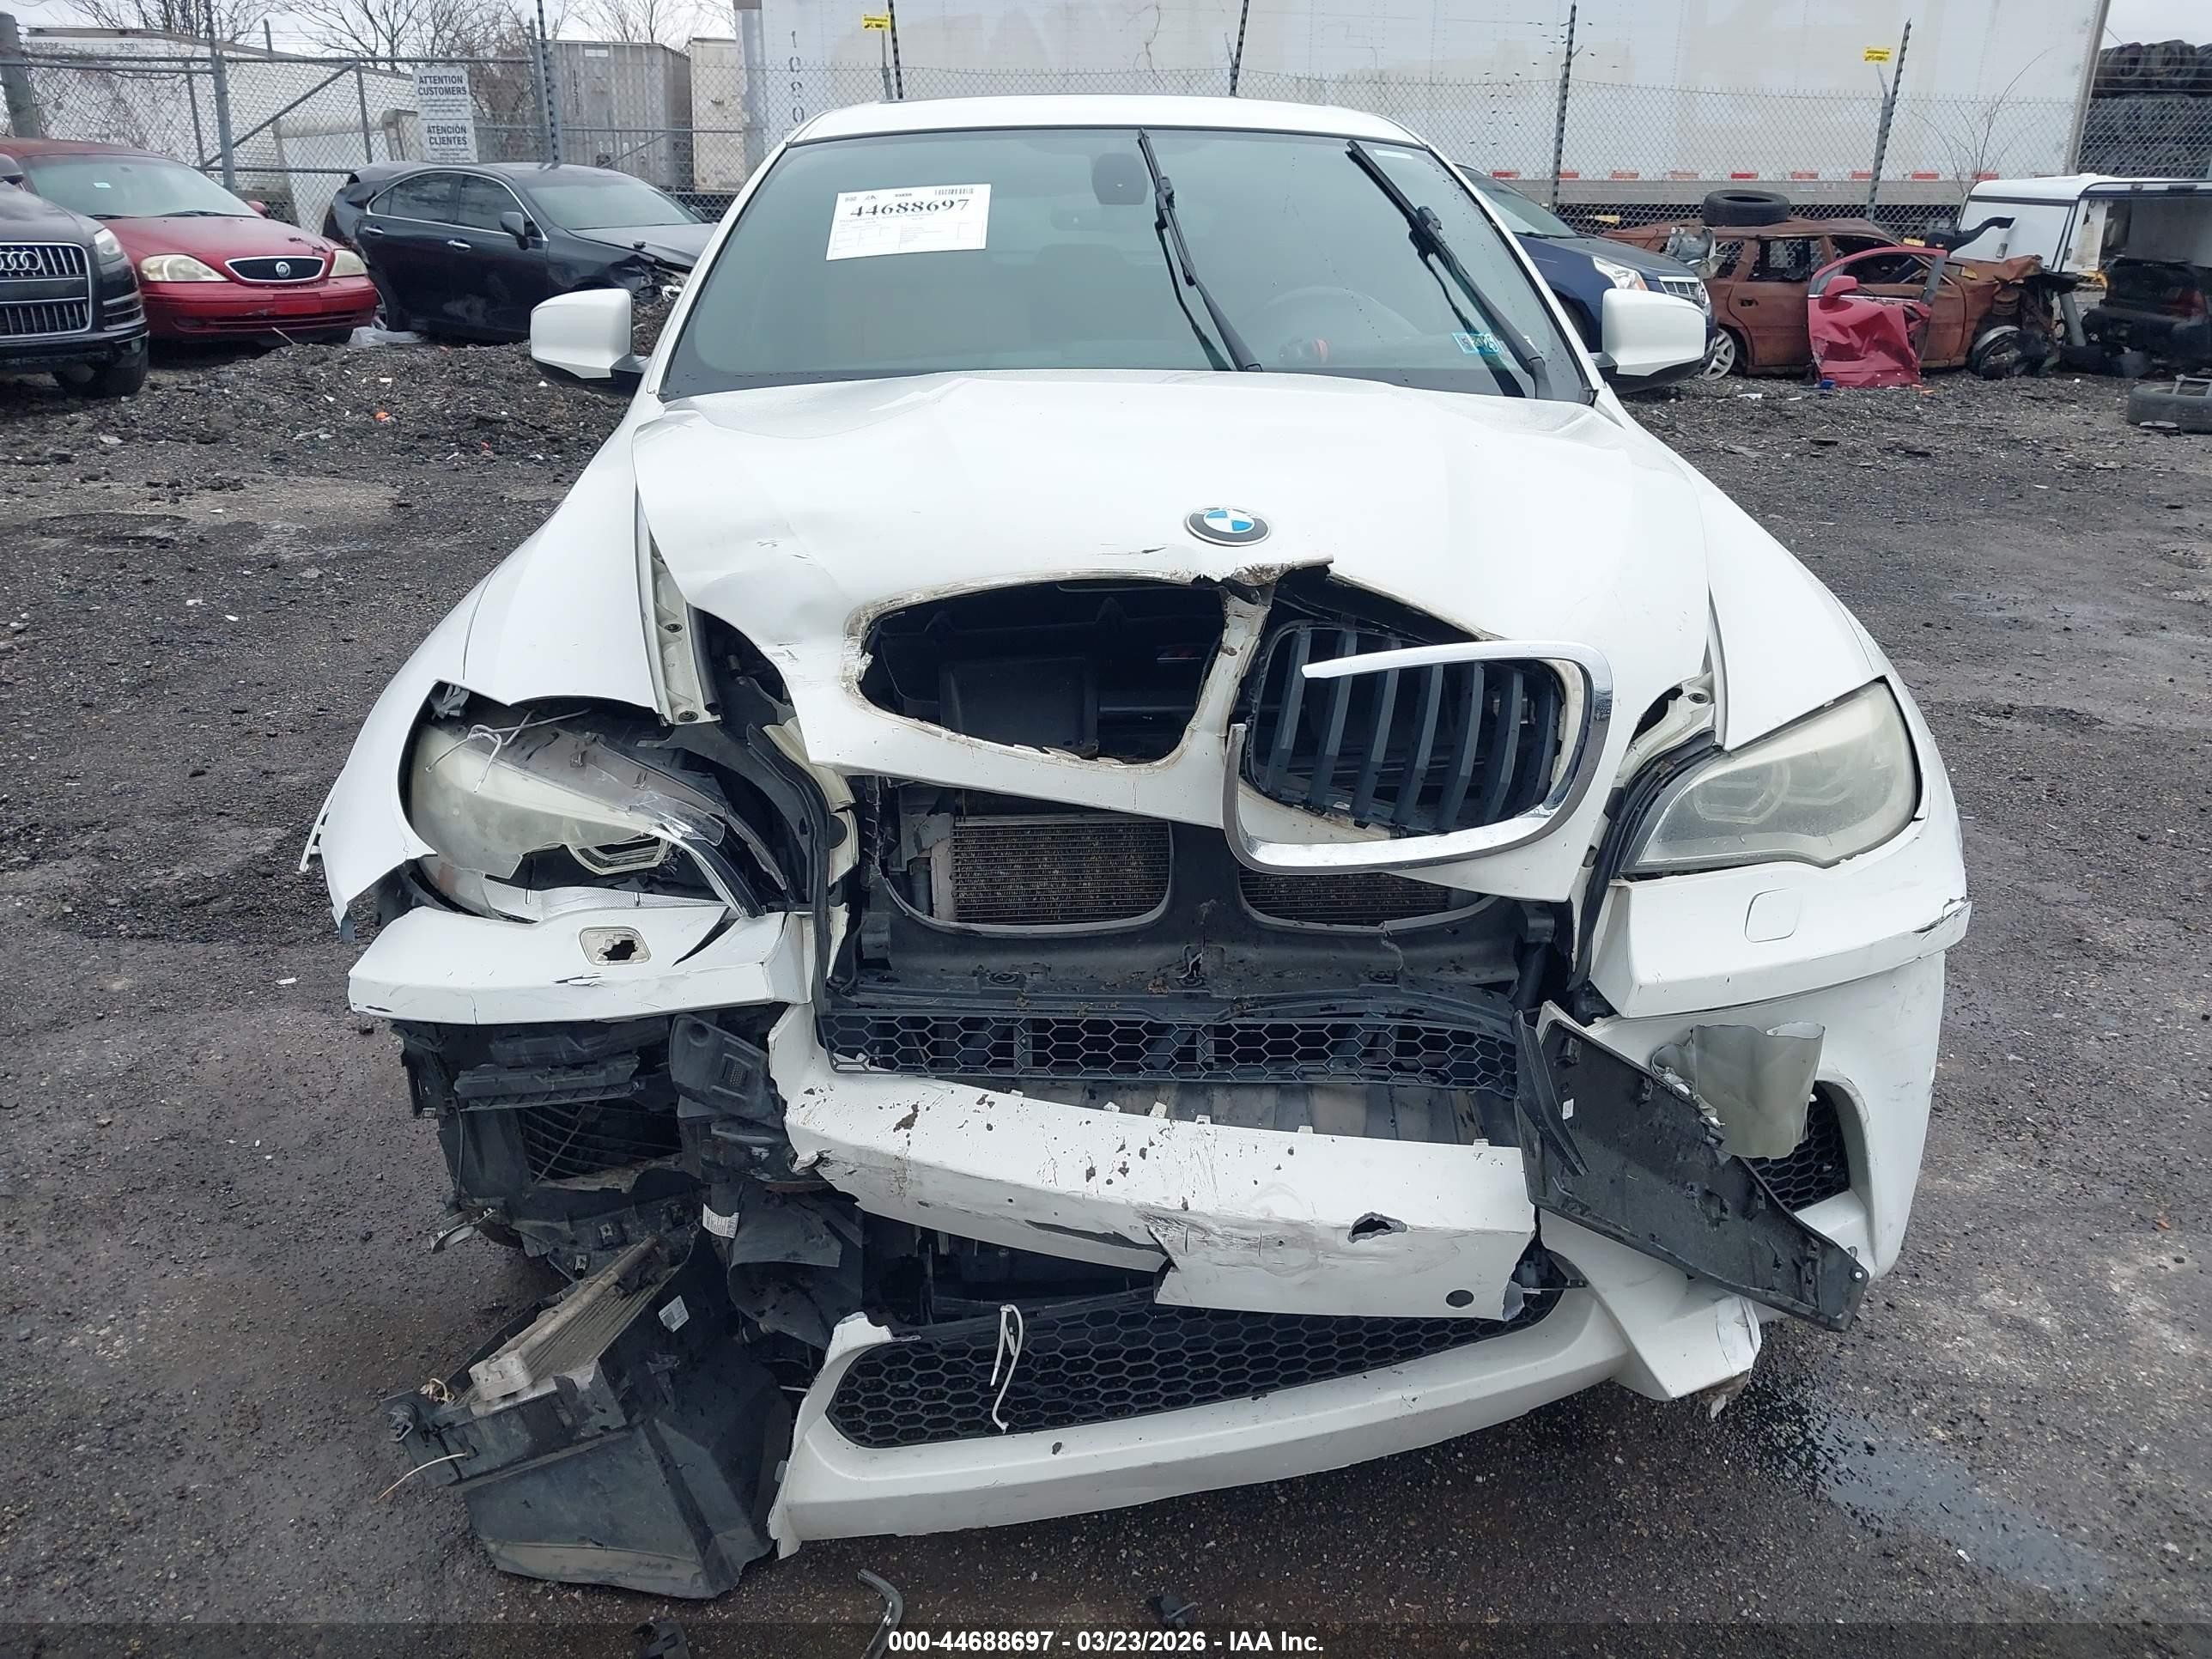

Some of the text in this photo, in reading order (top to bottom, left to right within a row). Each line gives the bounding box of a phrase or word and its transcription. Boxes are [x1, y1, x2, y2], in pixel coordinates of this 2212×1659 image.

[418, 75, 463, 85] ATTENTION
[417, 86, 467, 96] CUSTOMERS
[427, 124, 467, 135] ATENCIÓN
[428, 137, 467, 145] CLIENTES
[850, 198, 970, 216] 44688697
